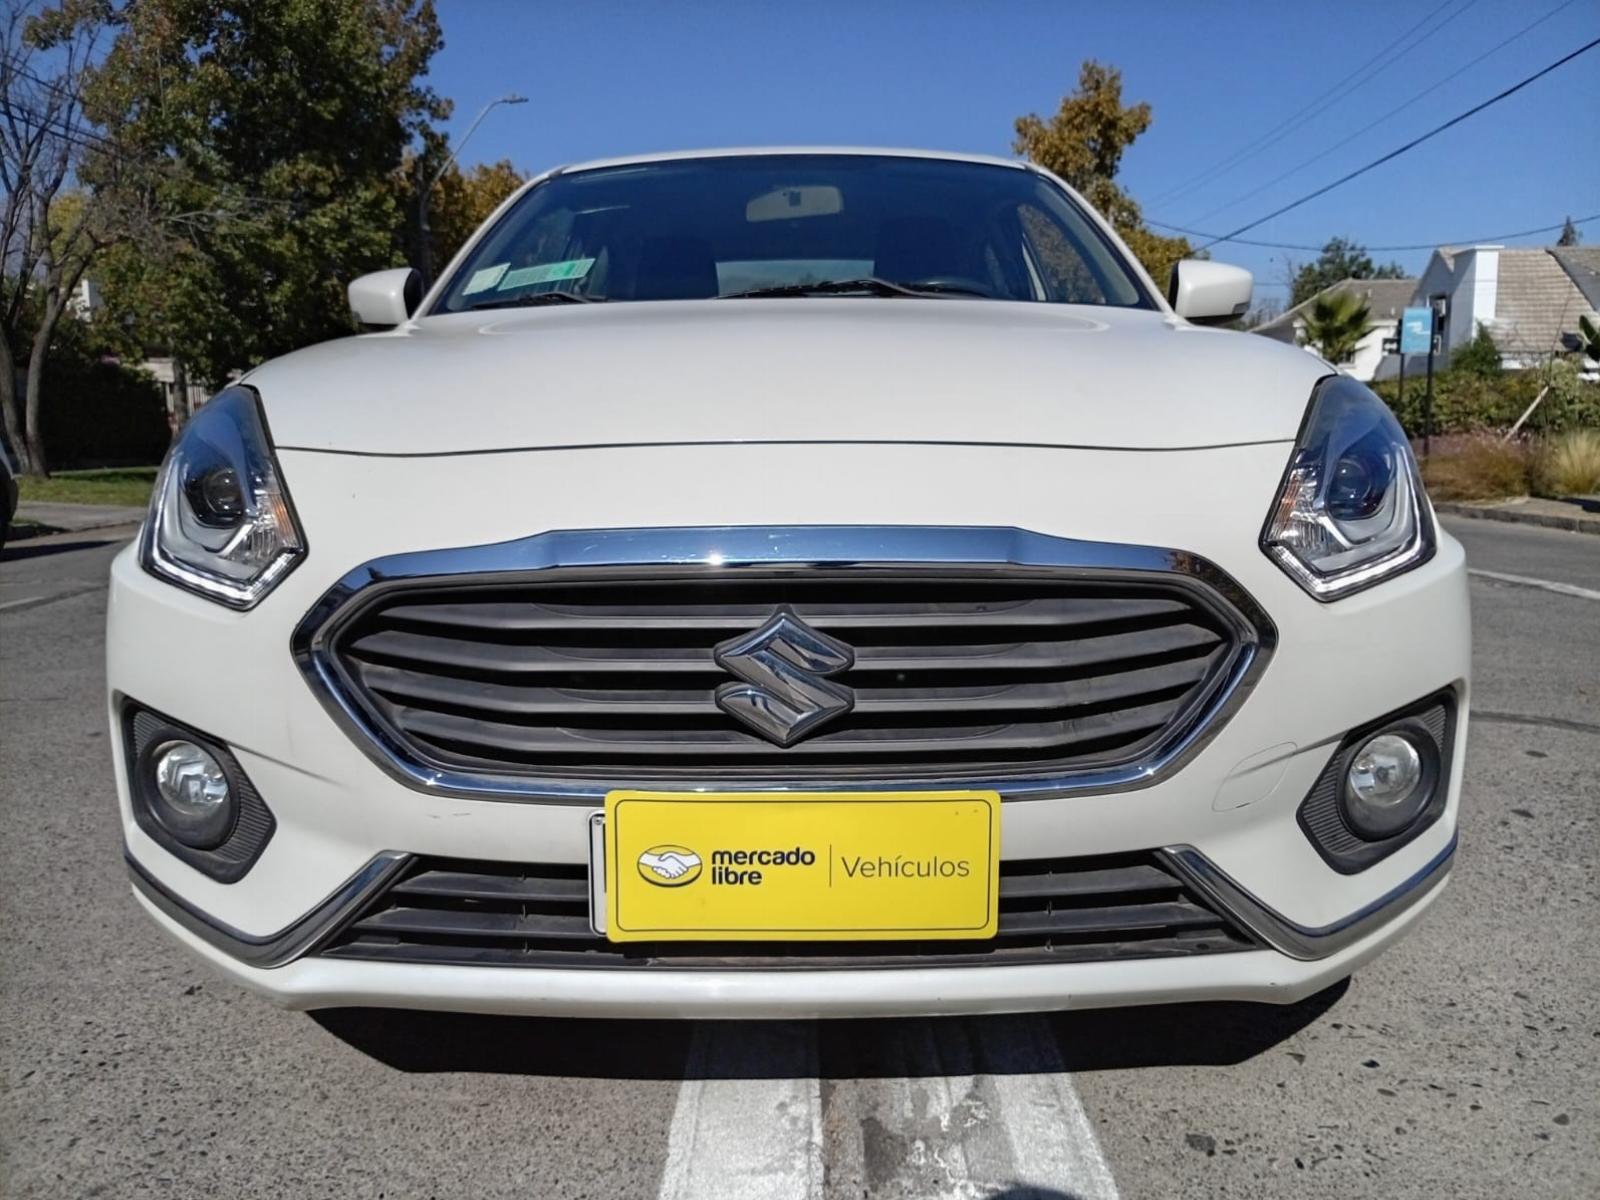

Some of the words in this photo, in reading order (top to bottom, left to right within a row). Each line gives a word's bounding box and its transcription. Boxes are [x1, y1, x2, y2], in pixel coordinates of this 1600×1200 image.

[711, 847, 815, 866] mercado
[711, 867, 762, 885] libre
[841, 855, 970, 878] Vehículos
